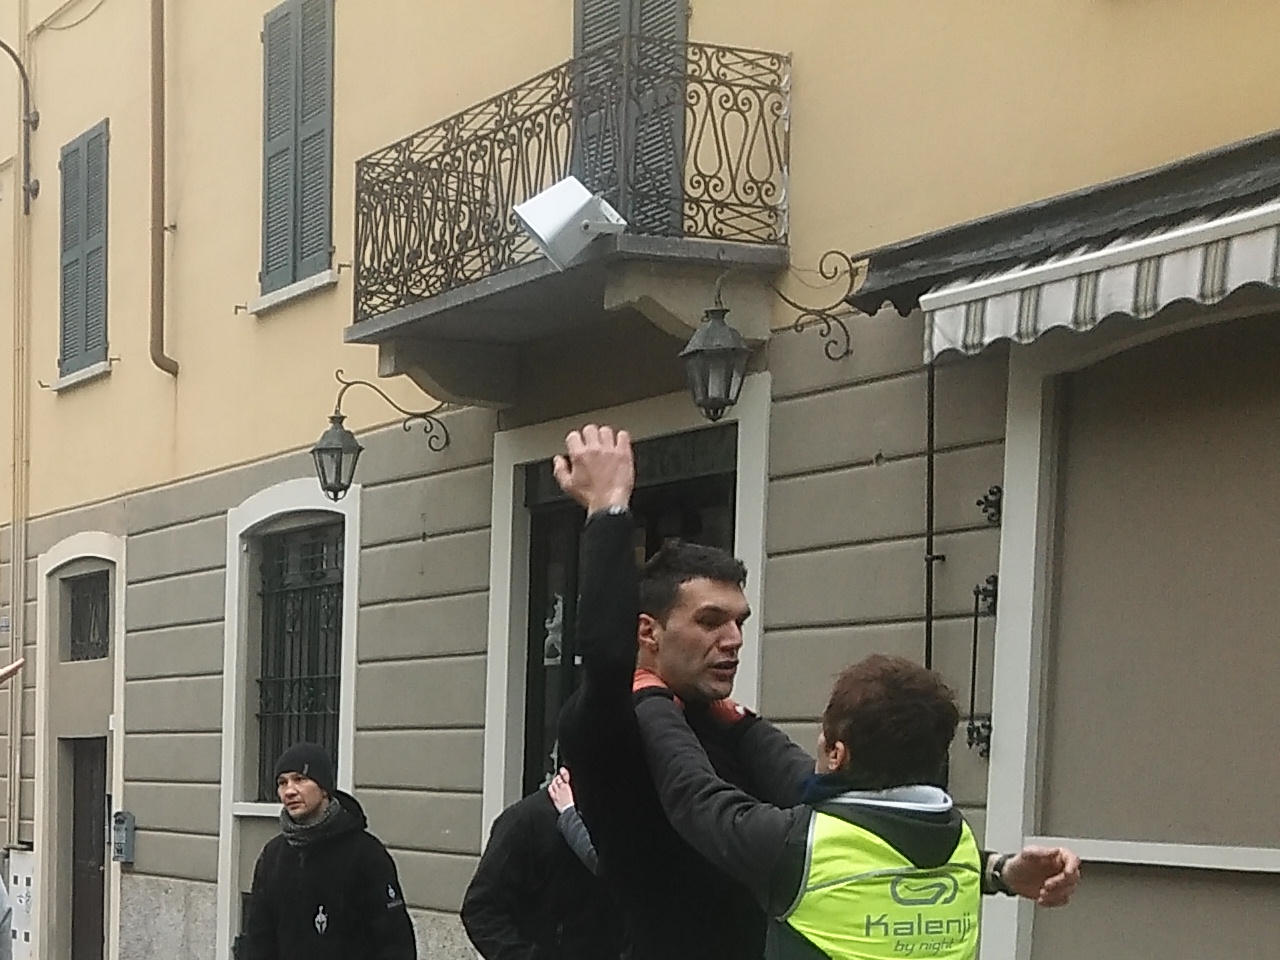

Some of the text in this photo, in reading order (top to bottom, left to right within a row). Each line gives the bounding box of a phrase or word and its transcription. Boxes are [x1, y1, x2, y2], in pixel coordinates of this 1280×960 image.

[865, 912, 971, 943] Kalenji
[893, 939, 955, 957] by night
